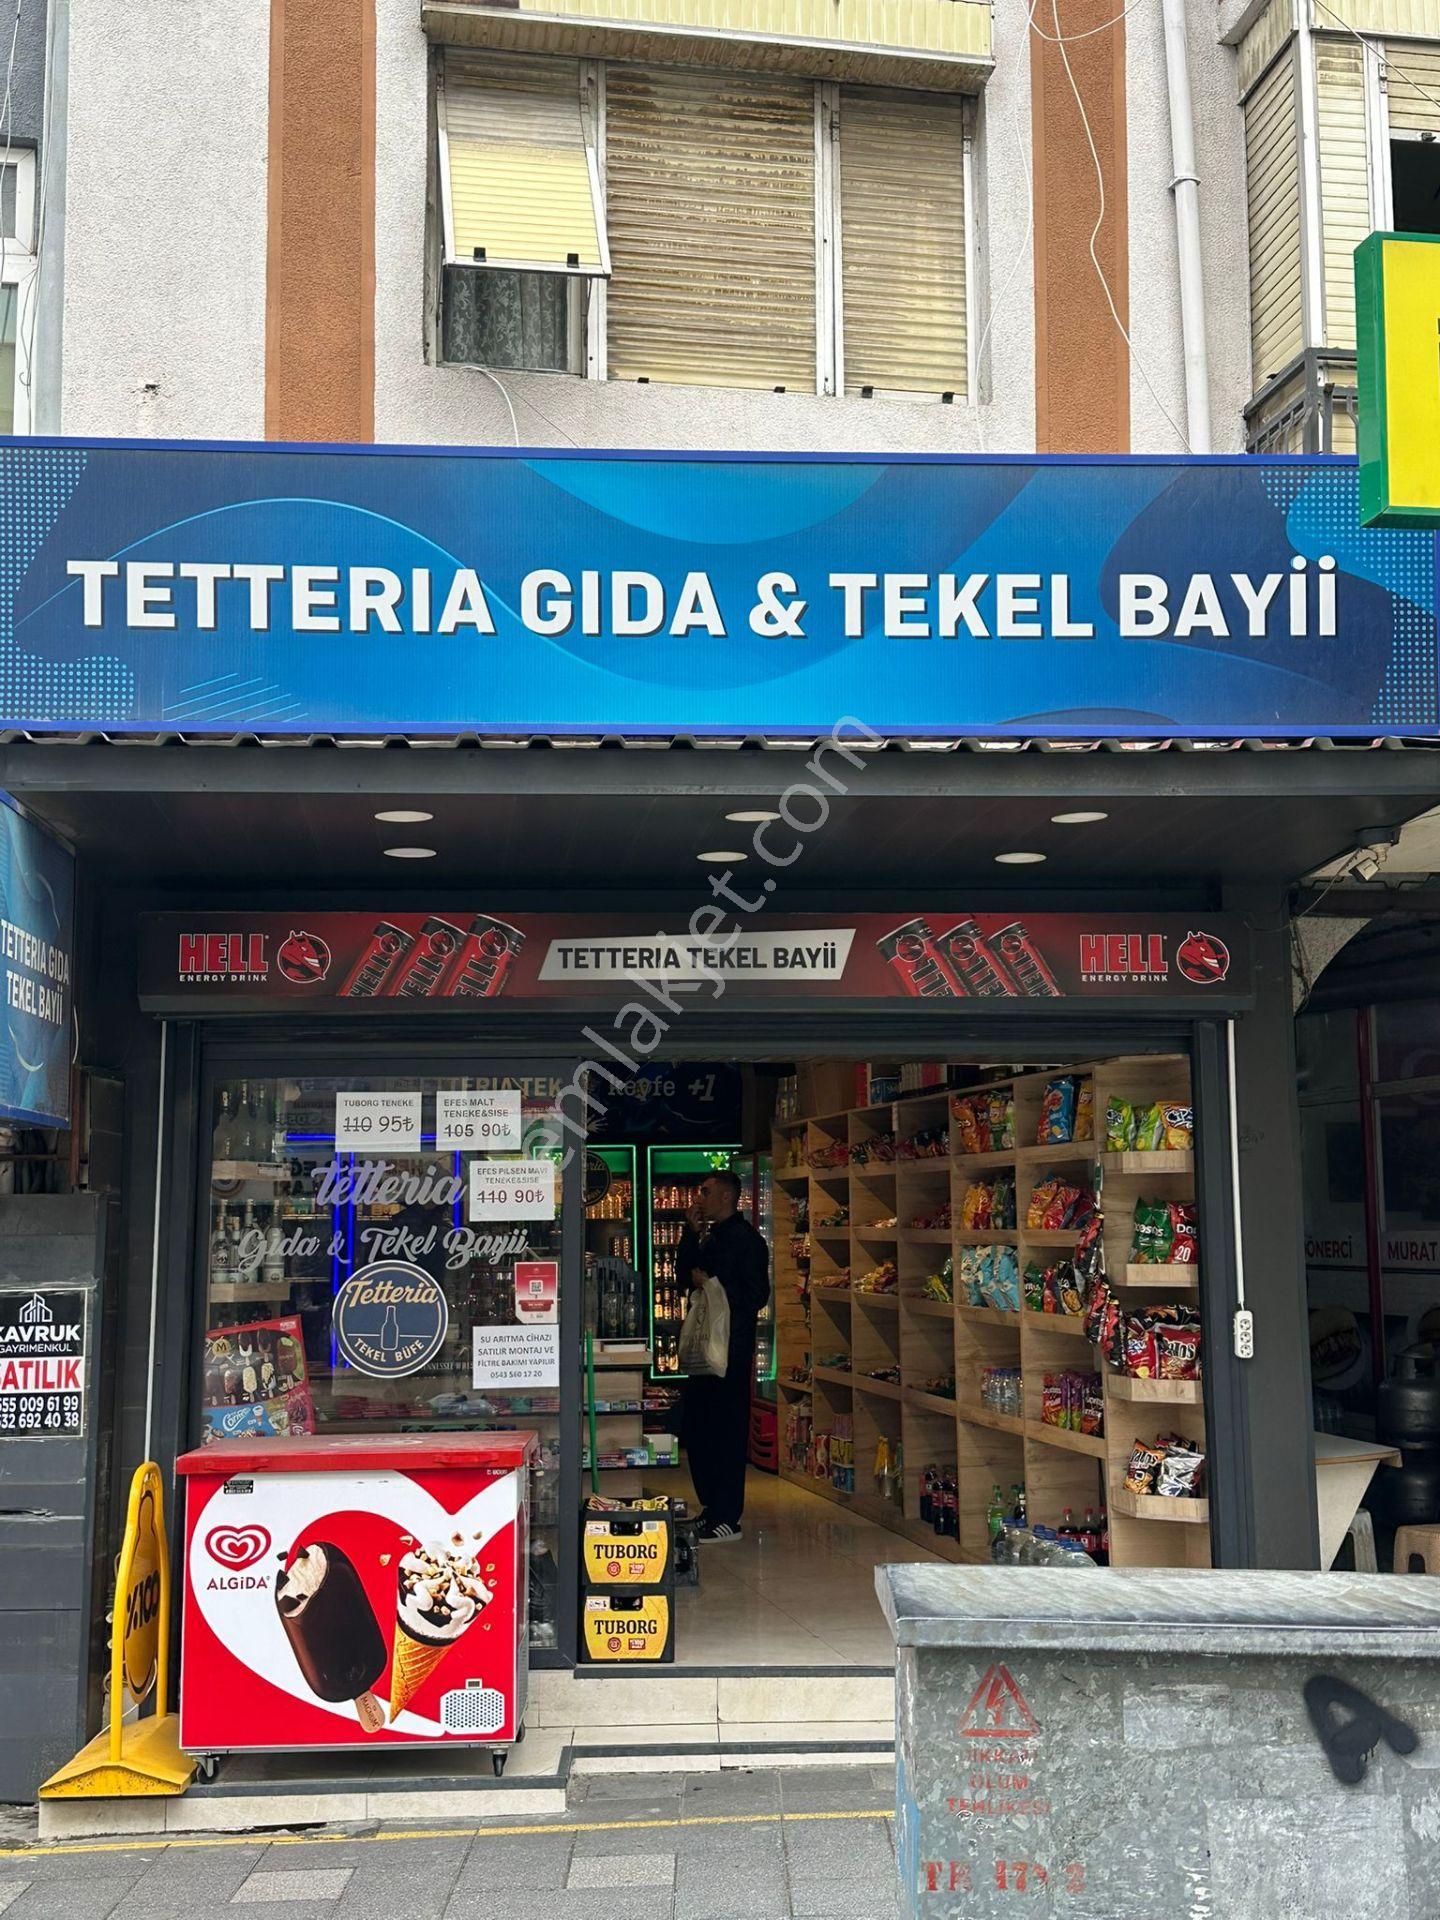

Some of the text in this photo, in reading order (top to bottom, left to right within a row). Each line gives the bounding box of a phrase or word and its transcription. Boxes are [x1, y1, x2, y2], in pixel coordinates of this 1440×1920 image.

[66, 554, 1338, 640] TETTERIA GIDA & TEKEL BAYİİ
[1, 919, 70, 985] TETTERIA GIDA
[179, 933, 269, 973] HELL
[558, 946, 681, 970] TETTERIA
[687, 946, 767, 969] TEKEL
[1080, 933, 1168, 973] HELL
[179, 974, 268, 982] ENERGY DRINK
[1082, 974, 1169, 982] ENERGY DRINK
[6, 969, 37, 1016] TEKEL
[343, 1099, 414, 1107] TUBORG TENEKE
[444, 1098, 496, 1107] EFES MALT
[477, 1167, 498, 1175] EFES
[326, 1230, 352, 1265] &
[360, 1225, 437, 1263] Tekel
[1387, 1240, 1438, 1262] MURAT
[345, 1280, 440, 1308] Tetteria
[480, 1335, 491, 1344] SU
[353, 1337, 425, 1363] TEKEL BÜFE
[508, 1347, 542, 1355] MONTAJ
[544, 1345, 554, 1354] VE
[0, 1359, 82, 1390] ATILIK
[533, 1370, 543, 1378] 20
[19, 1396, 44, 1412] 009
[47, 1396, 60, 1411] 61
[63, 1395, 79, 1411] 99
[18, 1413, 42, 1428] 692
[44, 1413, 62, 1428] 40
[64, 1412, 79, 1427] 38
[593, 1544, 658, 1560] TUBORG
[593, 1619, 658, 1635] TUBORG
